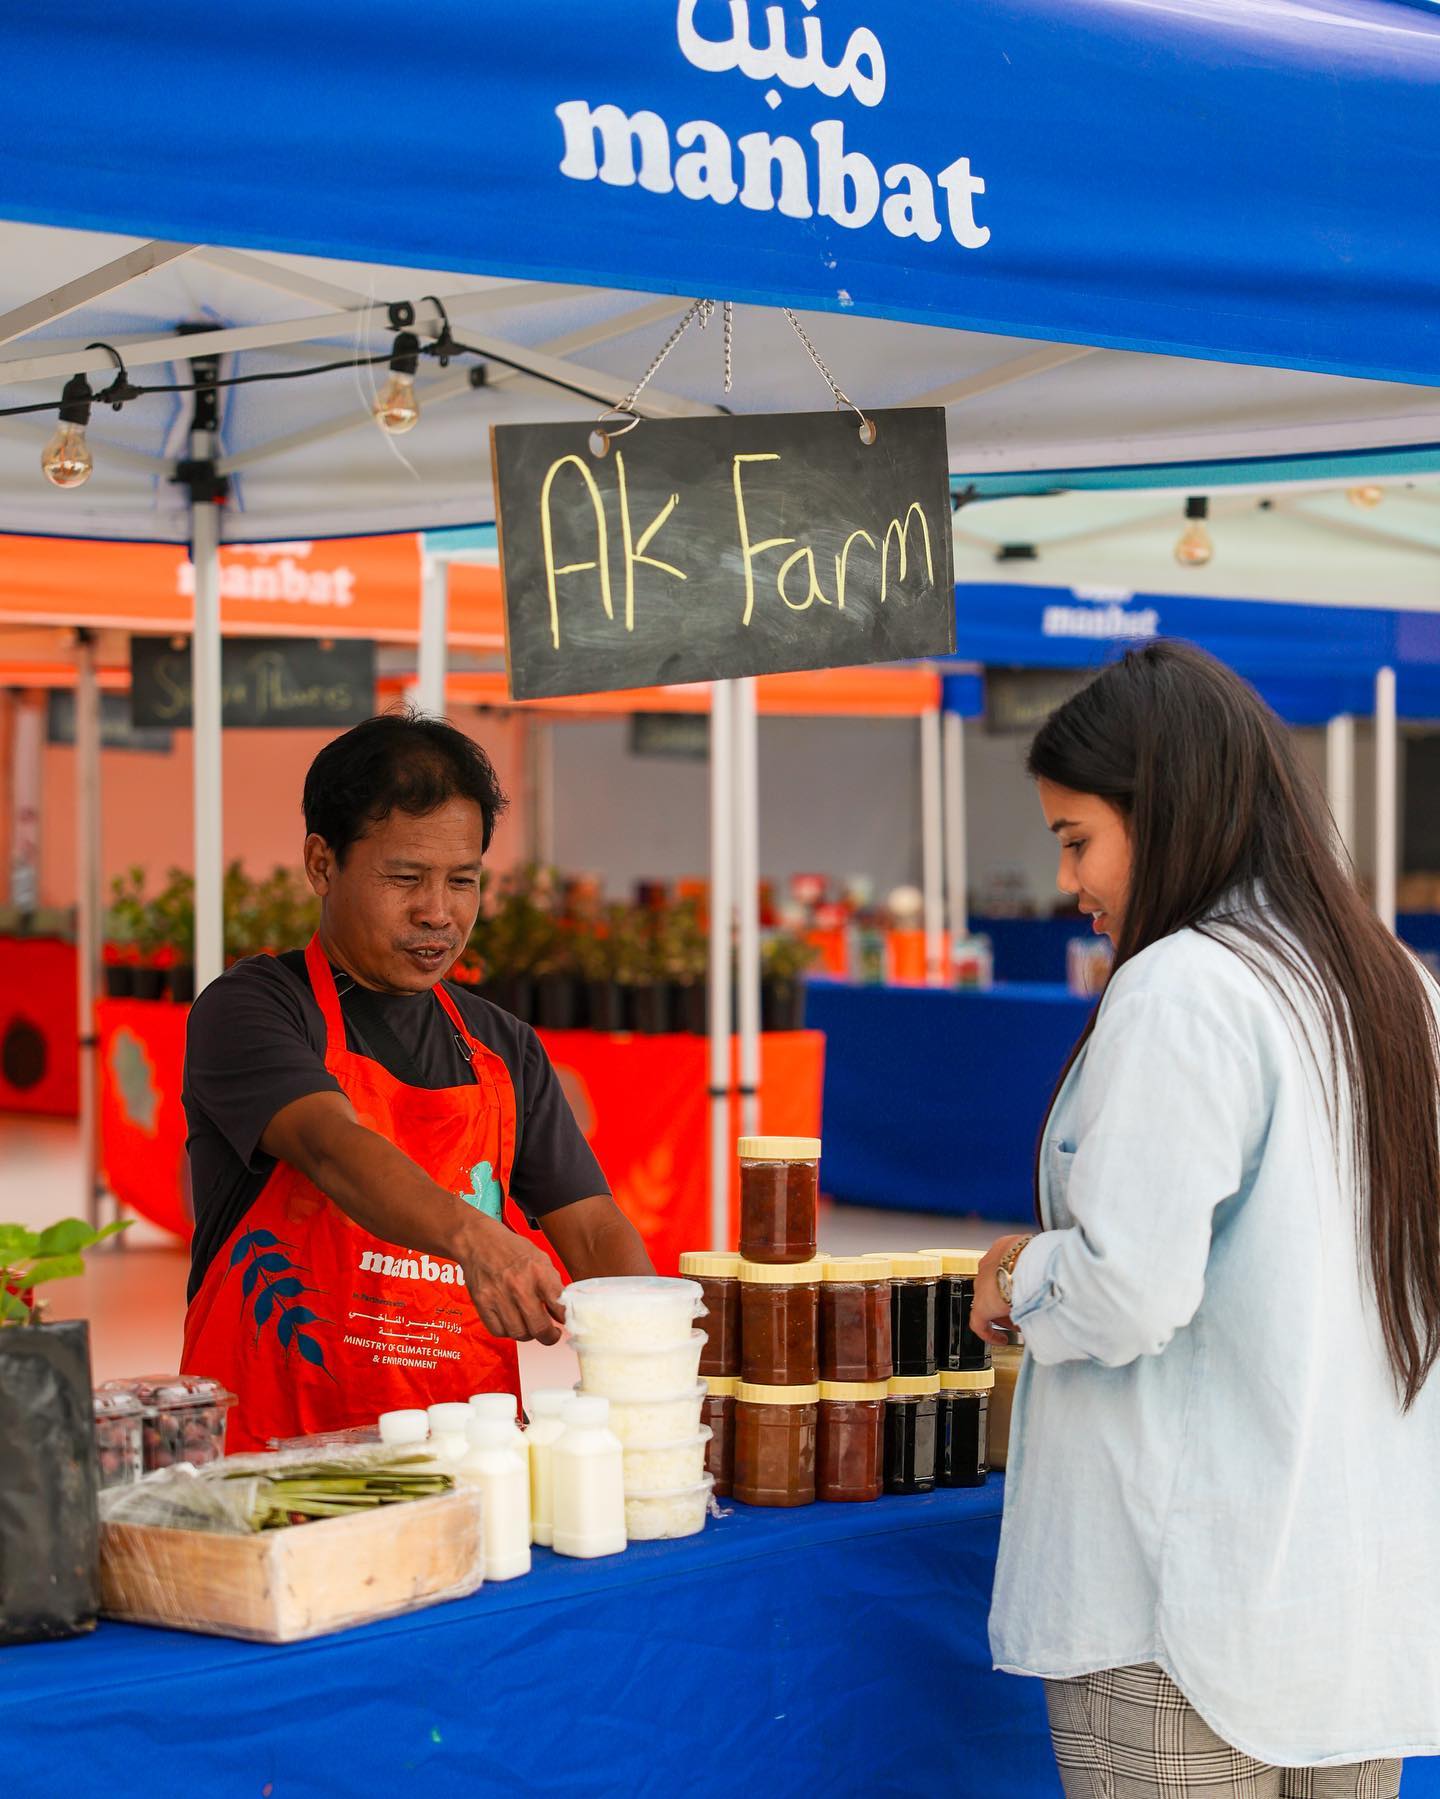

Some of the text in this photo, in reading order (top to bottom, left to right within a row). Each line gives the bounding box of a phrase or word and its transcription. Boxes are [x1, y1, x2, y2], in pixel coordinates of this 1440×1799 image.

[554, 100, 991, 249] manbat
[733, 453, 935, 626] Farm
[343, 1335, 387, 1352] MINISTRY
[397, 1344, 431, 1356] CLIMATE
[432, 1348, 461, 1360] CHANGE
[372, 1354, 381, 1363] &
